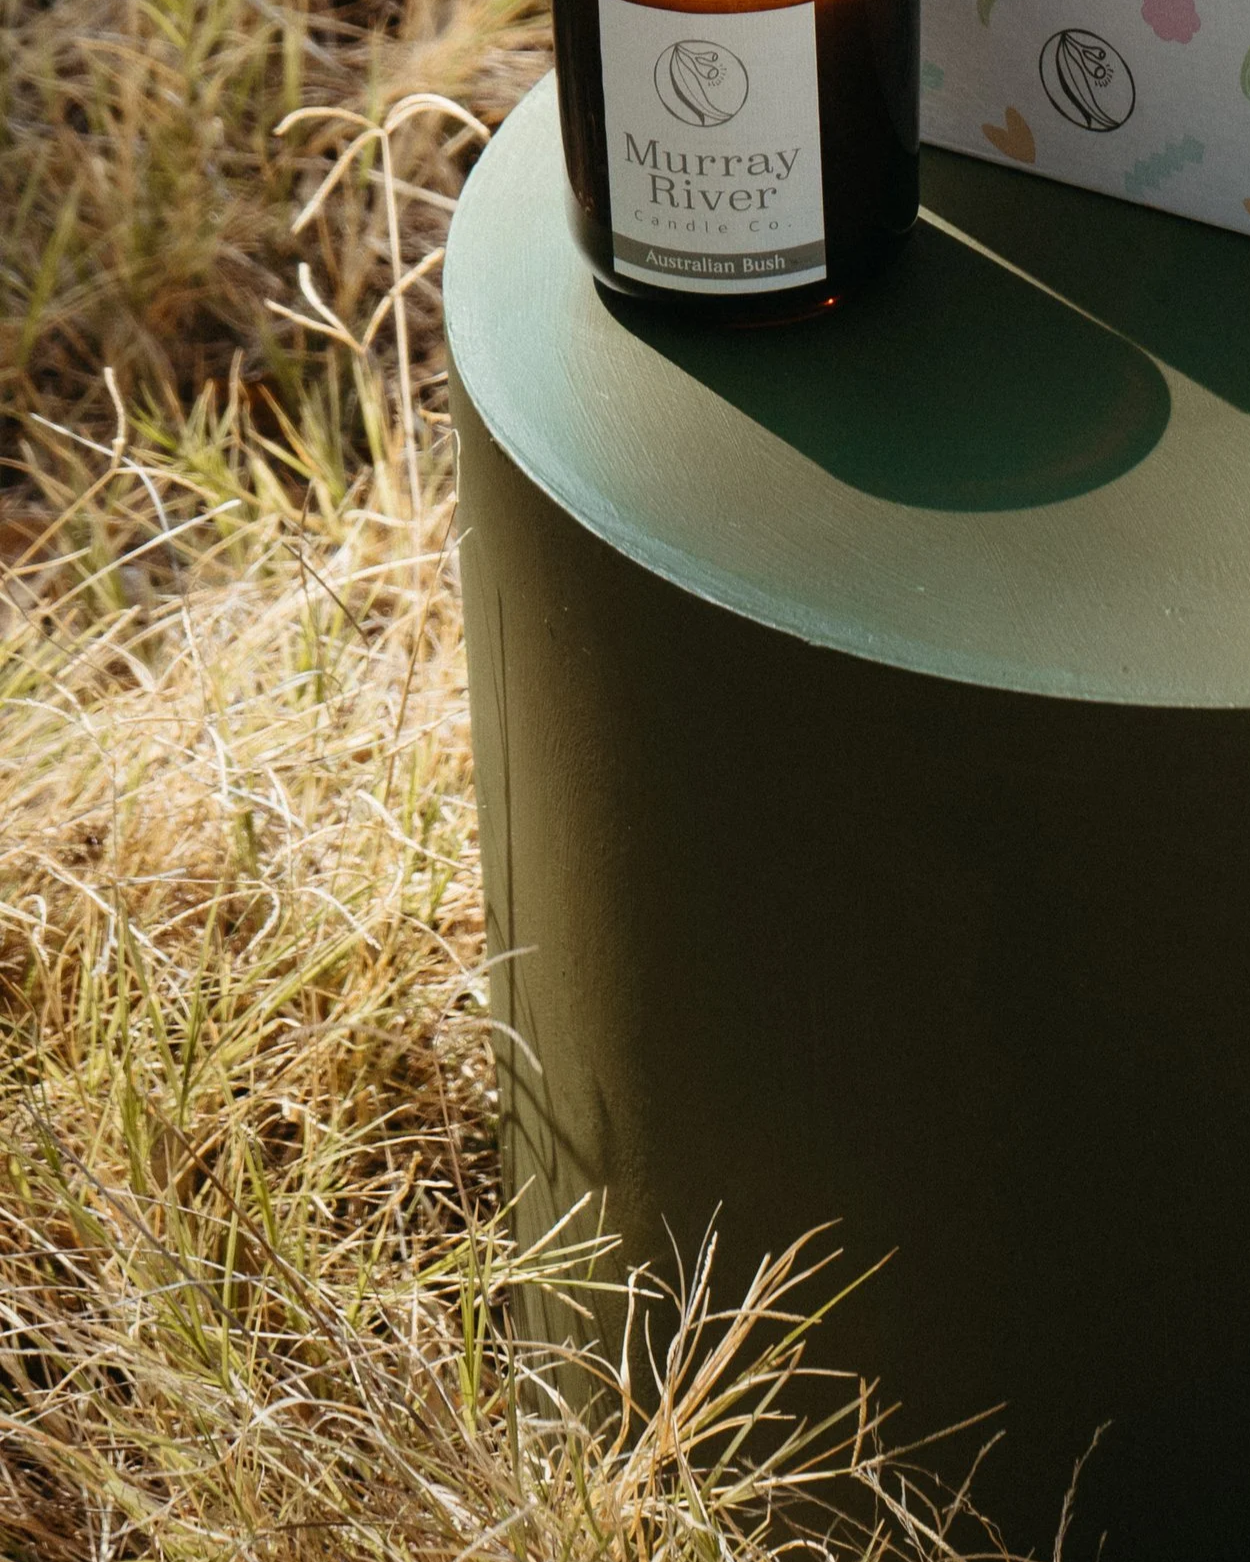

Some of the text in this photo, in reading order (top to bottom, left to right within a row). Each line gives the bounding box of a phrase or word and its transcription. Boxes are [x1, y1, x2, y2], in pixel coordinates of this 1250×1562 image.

[624, 131, 801, 181] Murray
[648, 173, 777, 212] River
[634, 209, 793, 234] Candle Co.
[645, 249, 786, 274] Australian Bush
